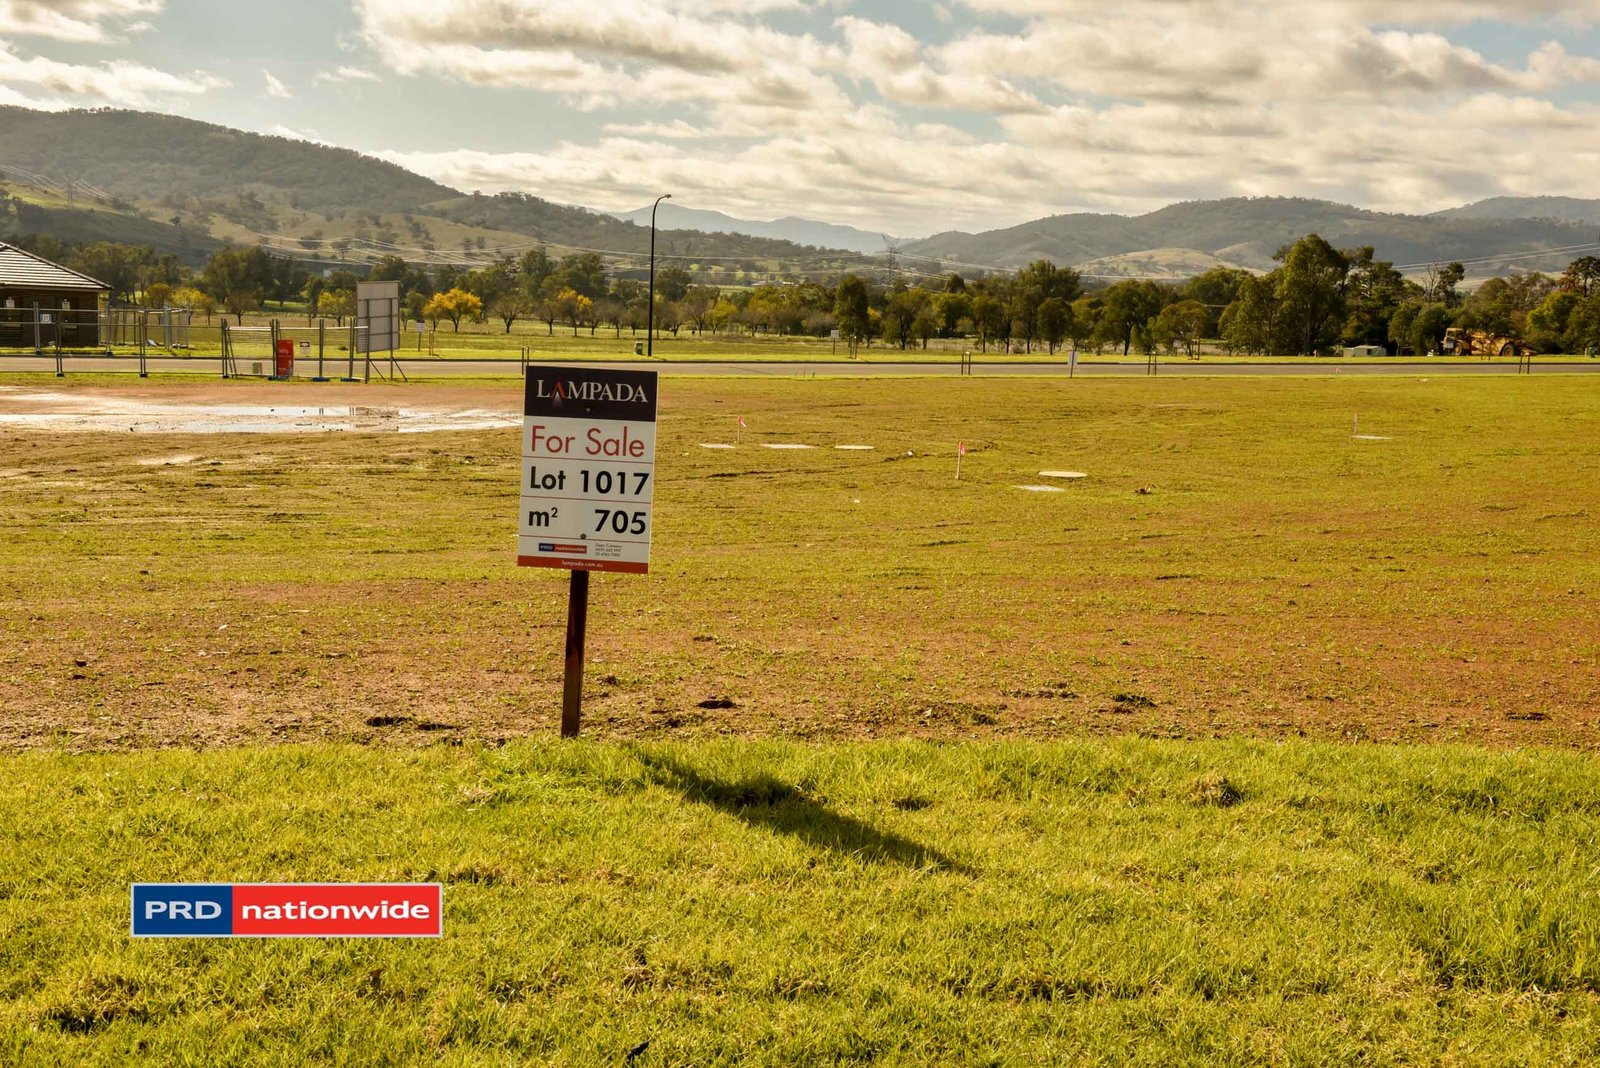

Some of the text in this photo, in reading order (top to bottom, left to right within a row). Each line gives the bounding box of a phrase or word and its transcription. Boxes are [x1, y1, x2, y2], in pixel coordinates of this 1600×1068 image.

[536, 380, 648, 403] LAMPADA
[531, 425, 645, 458] For Sale
[530, 466, 650, 495] Lot 1017
[594, 509, 647, 535] 705
